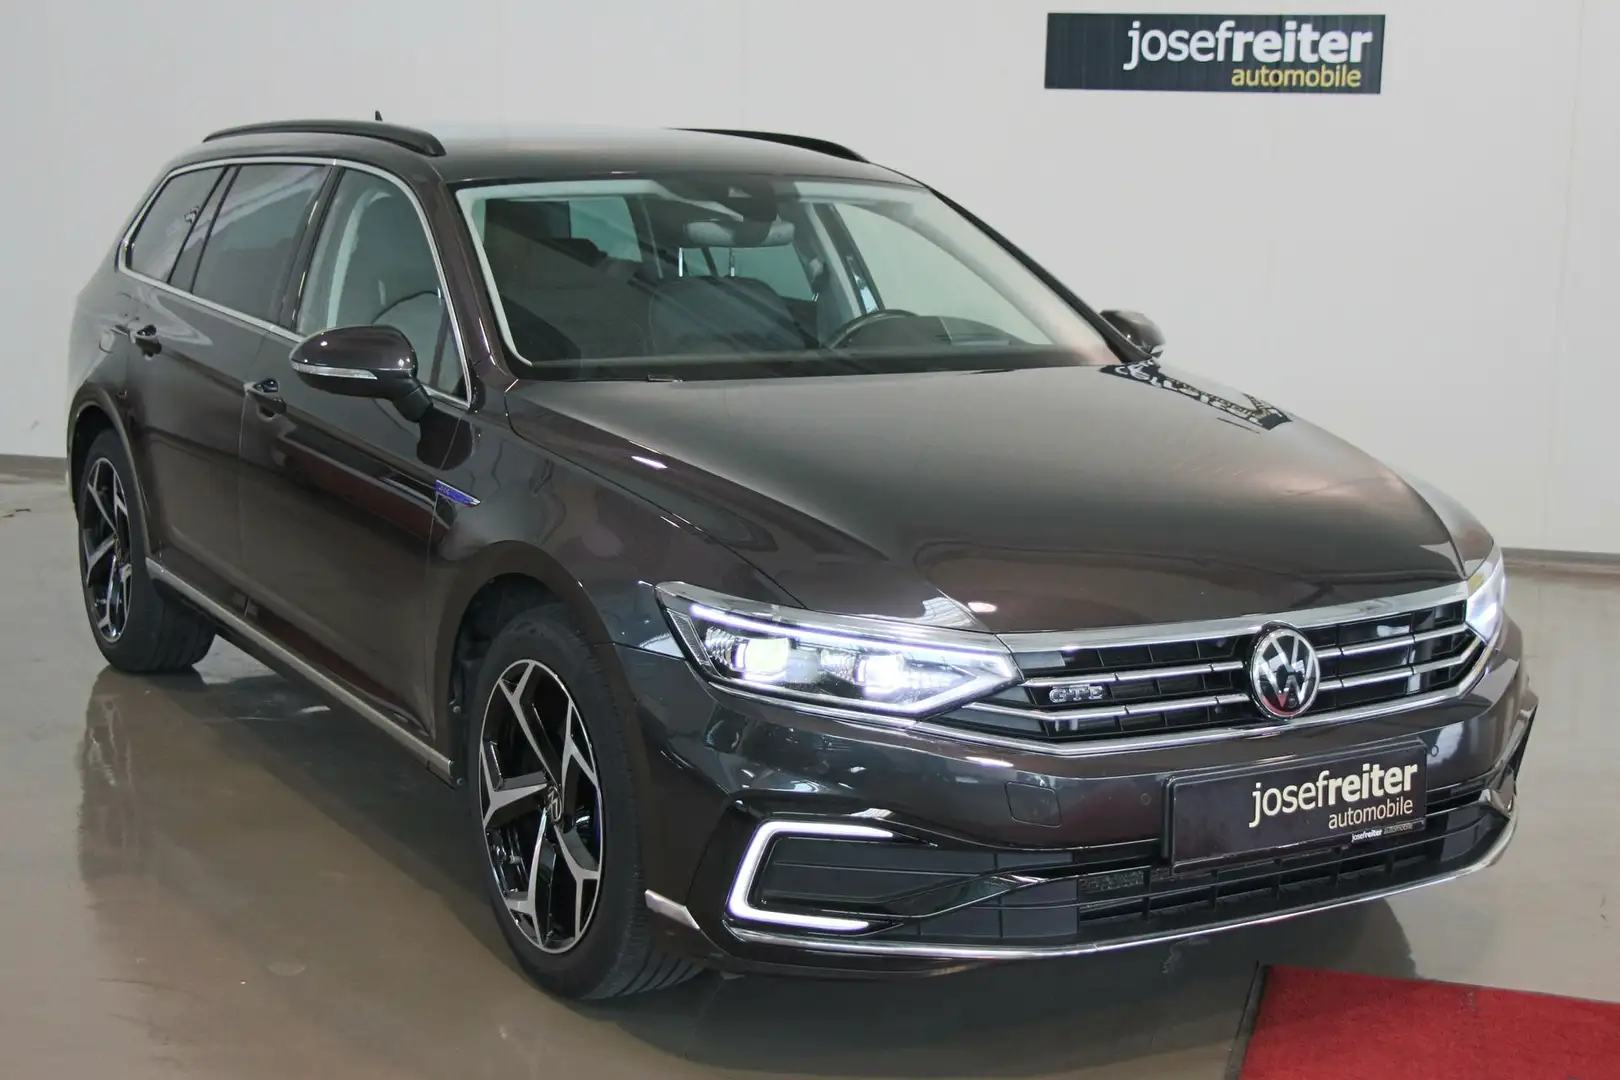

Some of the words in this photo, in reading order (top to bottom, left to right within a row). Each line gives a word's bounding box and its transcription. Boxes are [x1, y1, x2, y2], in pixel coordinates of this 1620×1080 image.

[1122, 20, 1374, 71] josefreiter
[1231, 65, 1362, 88] automobile
[1049, 684, 1103, 703] GTE
[1248, 762, 1419, 828] josefreiter
[1328, 796, 1414, 829] automobile
